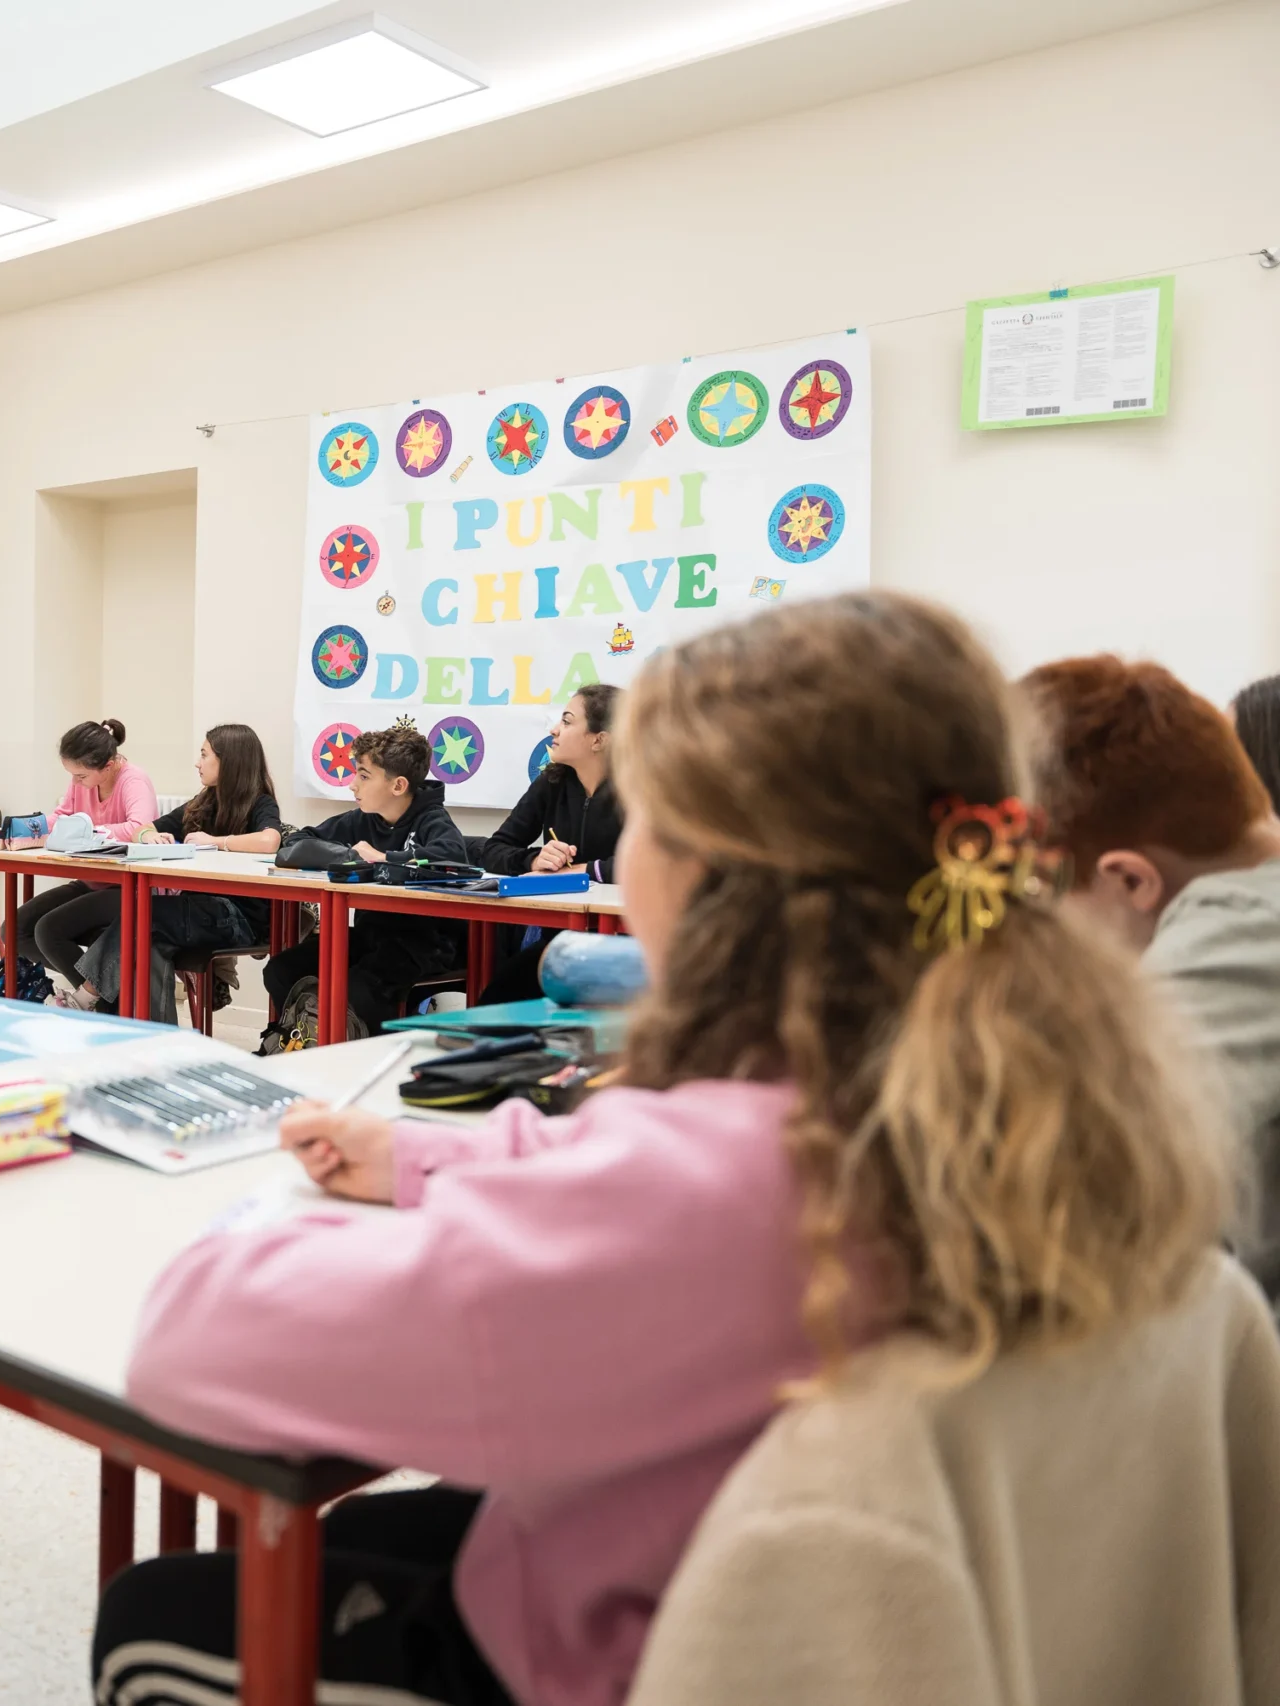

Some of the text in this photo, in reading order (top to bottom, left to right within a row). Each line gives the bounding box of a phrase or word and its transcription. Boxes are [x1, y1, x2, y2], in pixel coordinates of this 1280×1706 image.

[405, 471, 706, 551] I PUNTI
[421, 553, 718, 627] CHIAVE
[371, 652, 601, 706] DELLA
